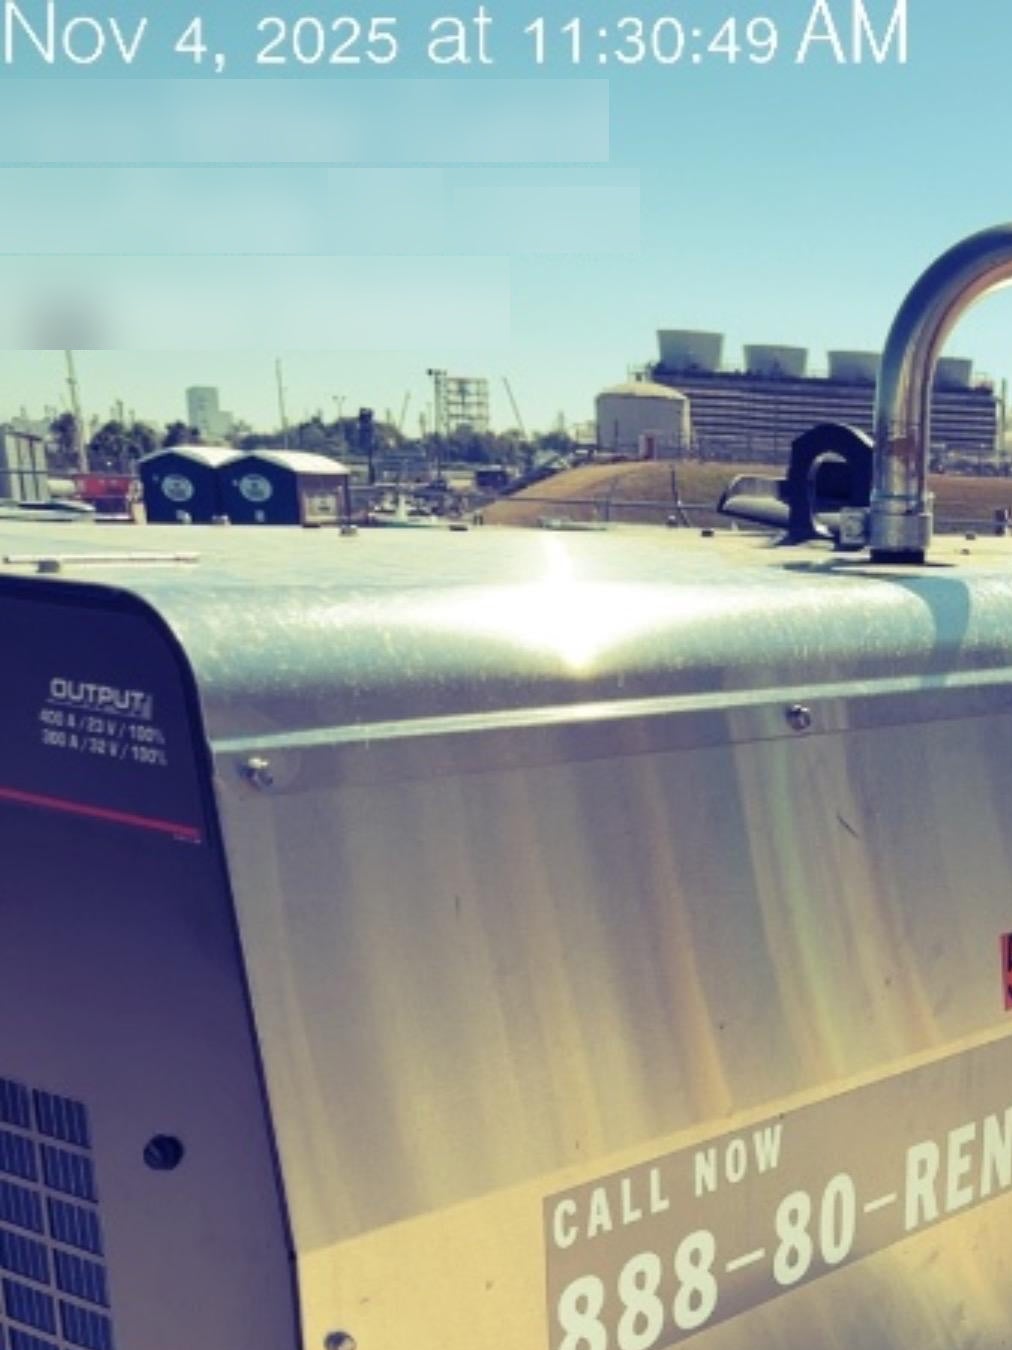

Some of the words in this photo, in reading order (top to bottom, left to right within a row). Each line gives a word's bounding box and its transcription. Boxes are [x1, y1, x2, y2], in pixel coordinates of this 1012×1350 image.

[49, 676, 145, 709] OUTPUT
[553, 1169, 669, 1248] CALL
[694, 1124, 783, 1198] NOW
